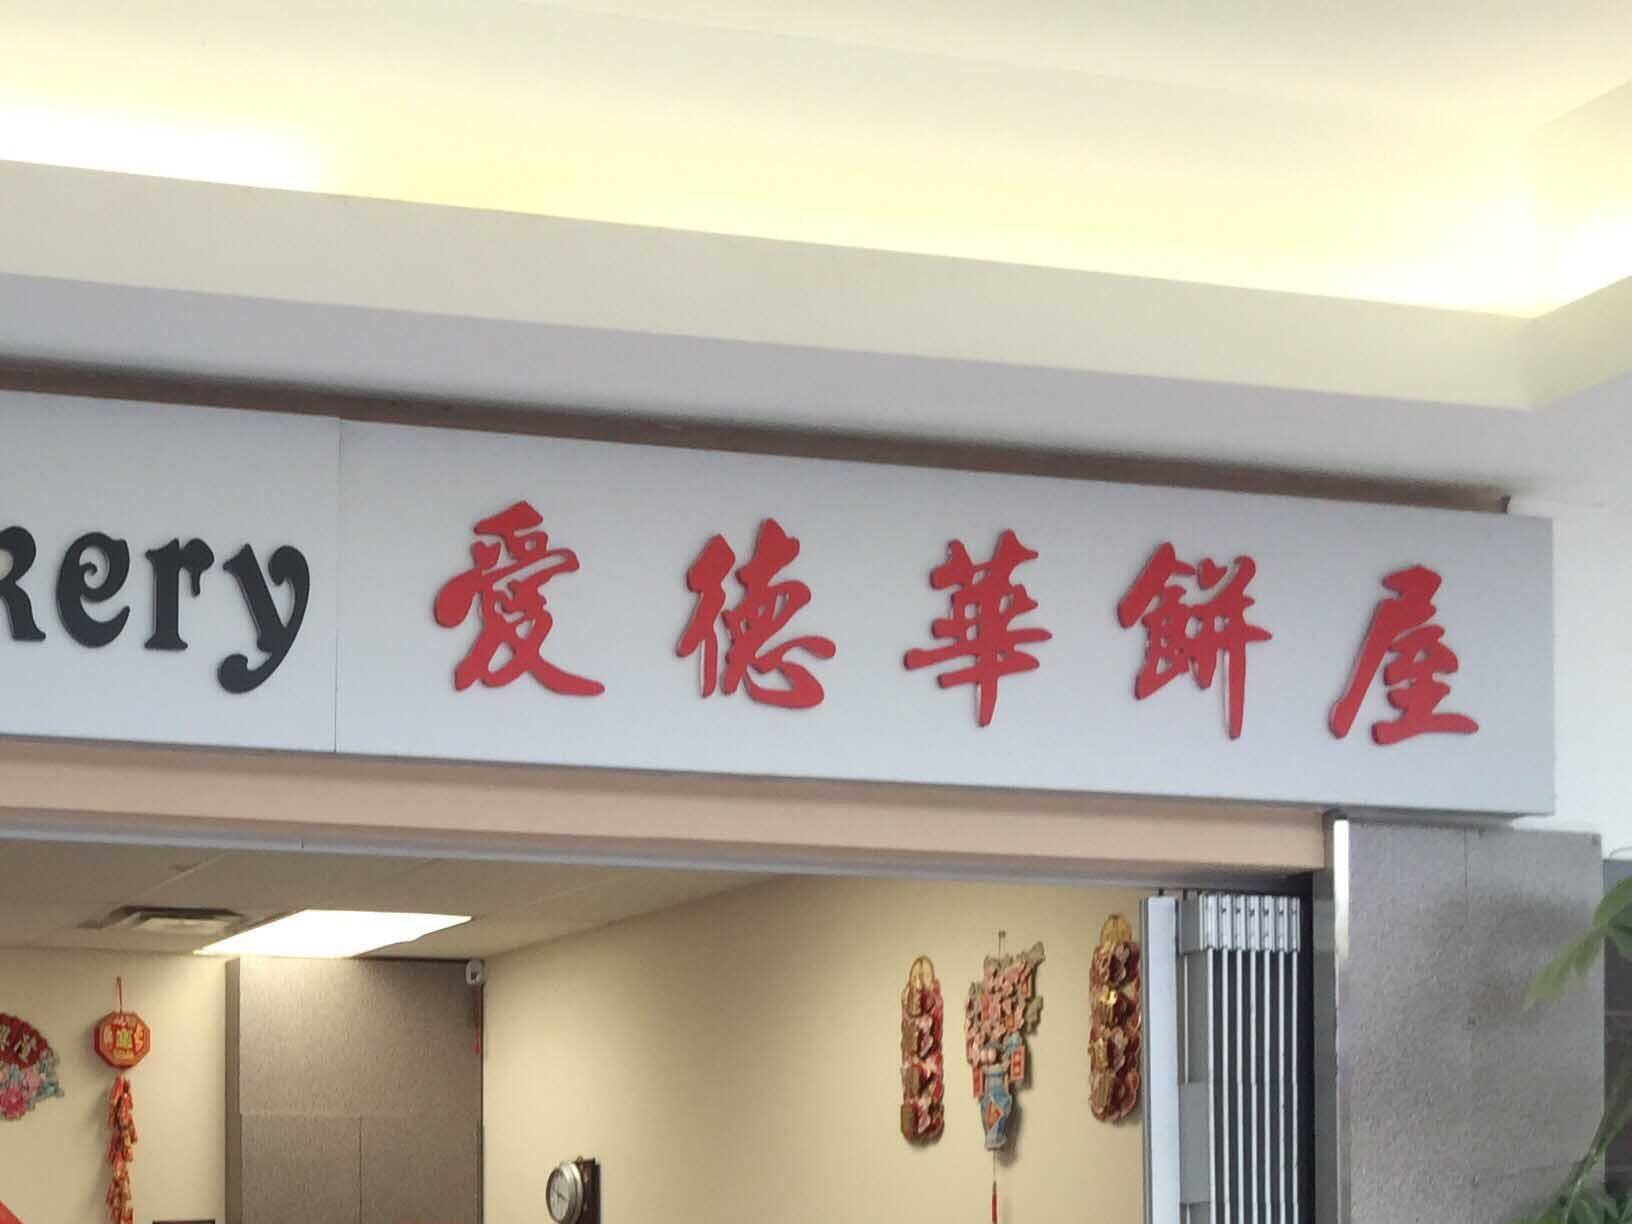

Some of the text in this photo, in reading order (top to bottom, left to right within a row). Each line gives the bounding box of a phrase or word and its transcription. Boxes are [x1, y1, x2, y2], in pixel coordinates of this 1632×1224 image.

[433, 502, 1479, 744] 愛德華餅屋
